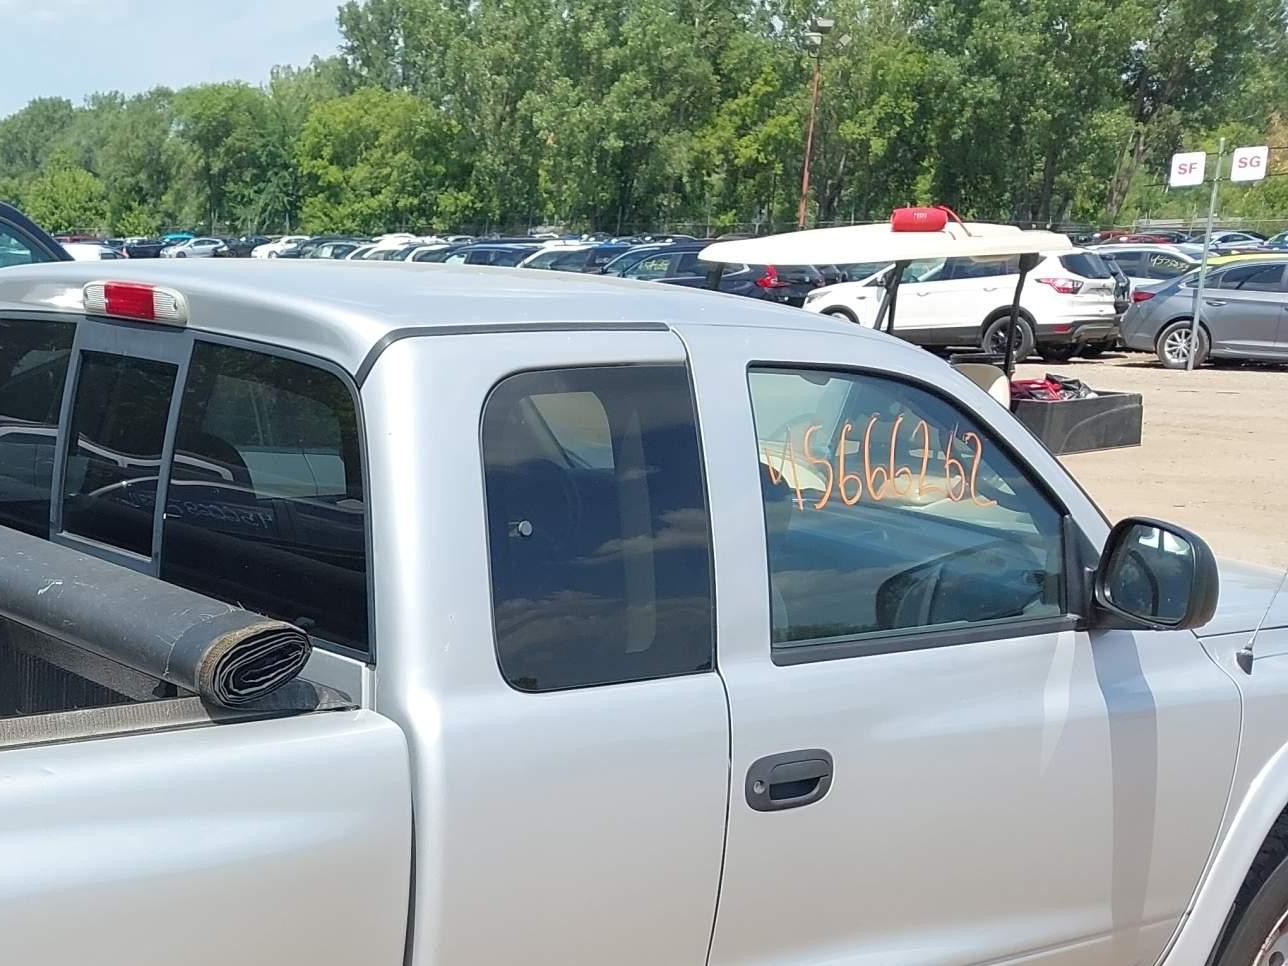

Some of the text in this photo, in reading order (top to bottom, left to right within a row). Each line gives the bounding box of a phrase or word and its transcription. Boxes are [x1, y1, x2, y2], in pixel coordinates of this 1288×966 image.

[1177, 162, 1198, 175] SF
[1238, 155, 1261, 169] SG
[761, 411, 998, 512] 45666262
